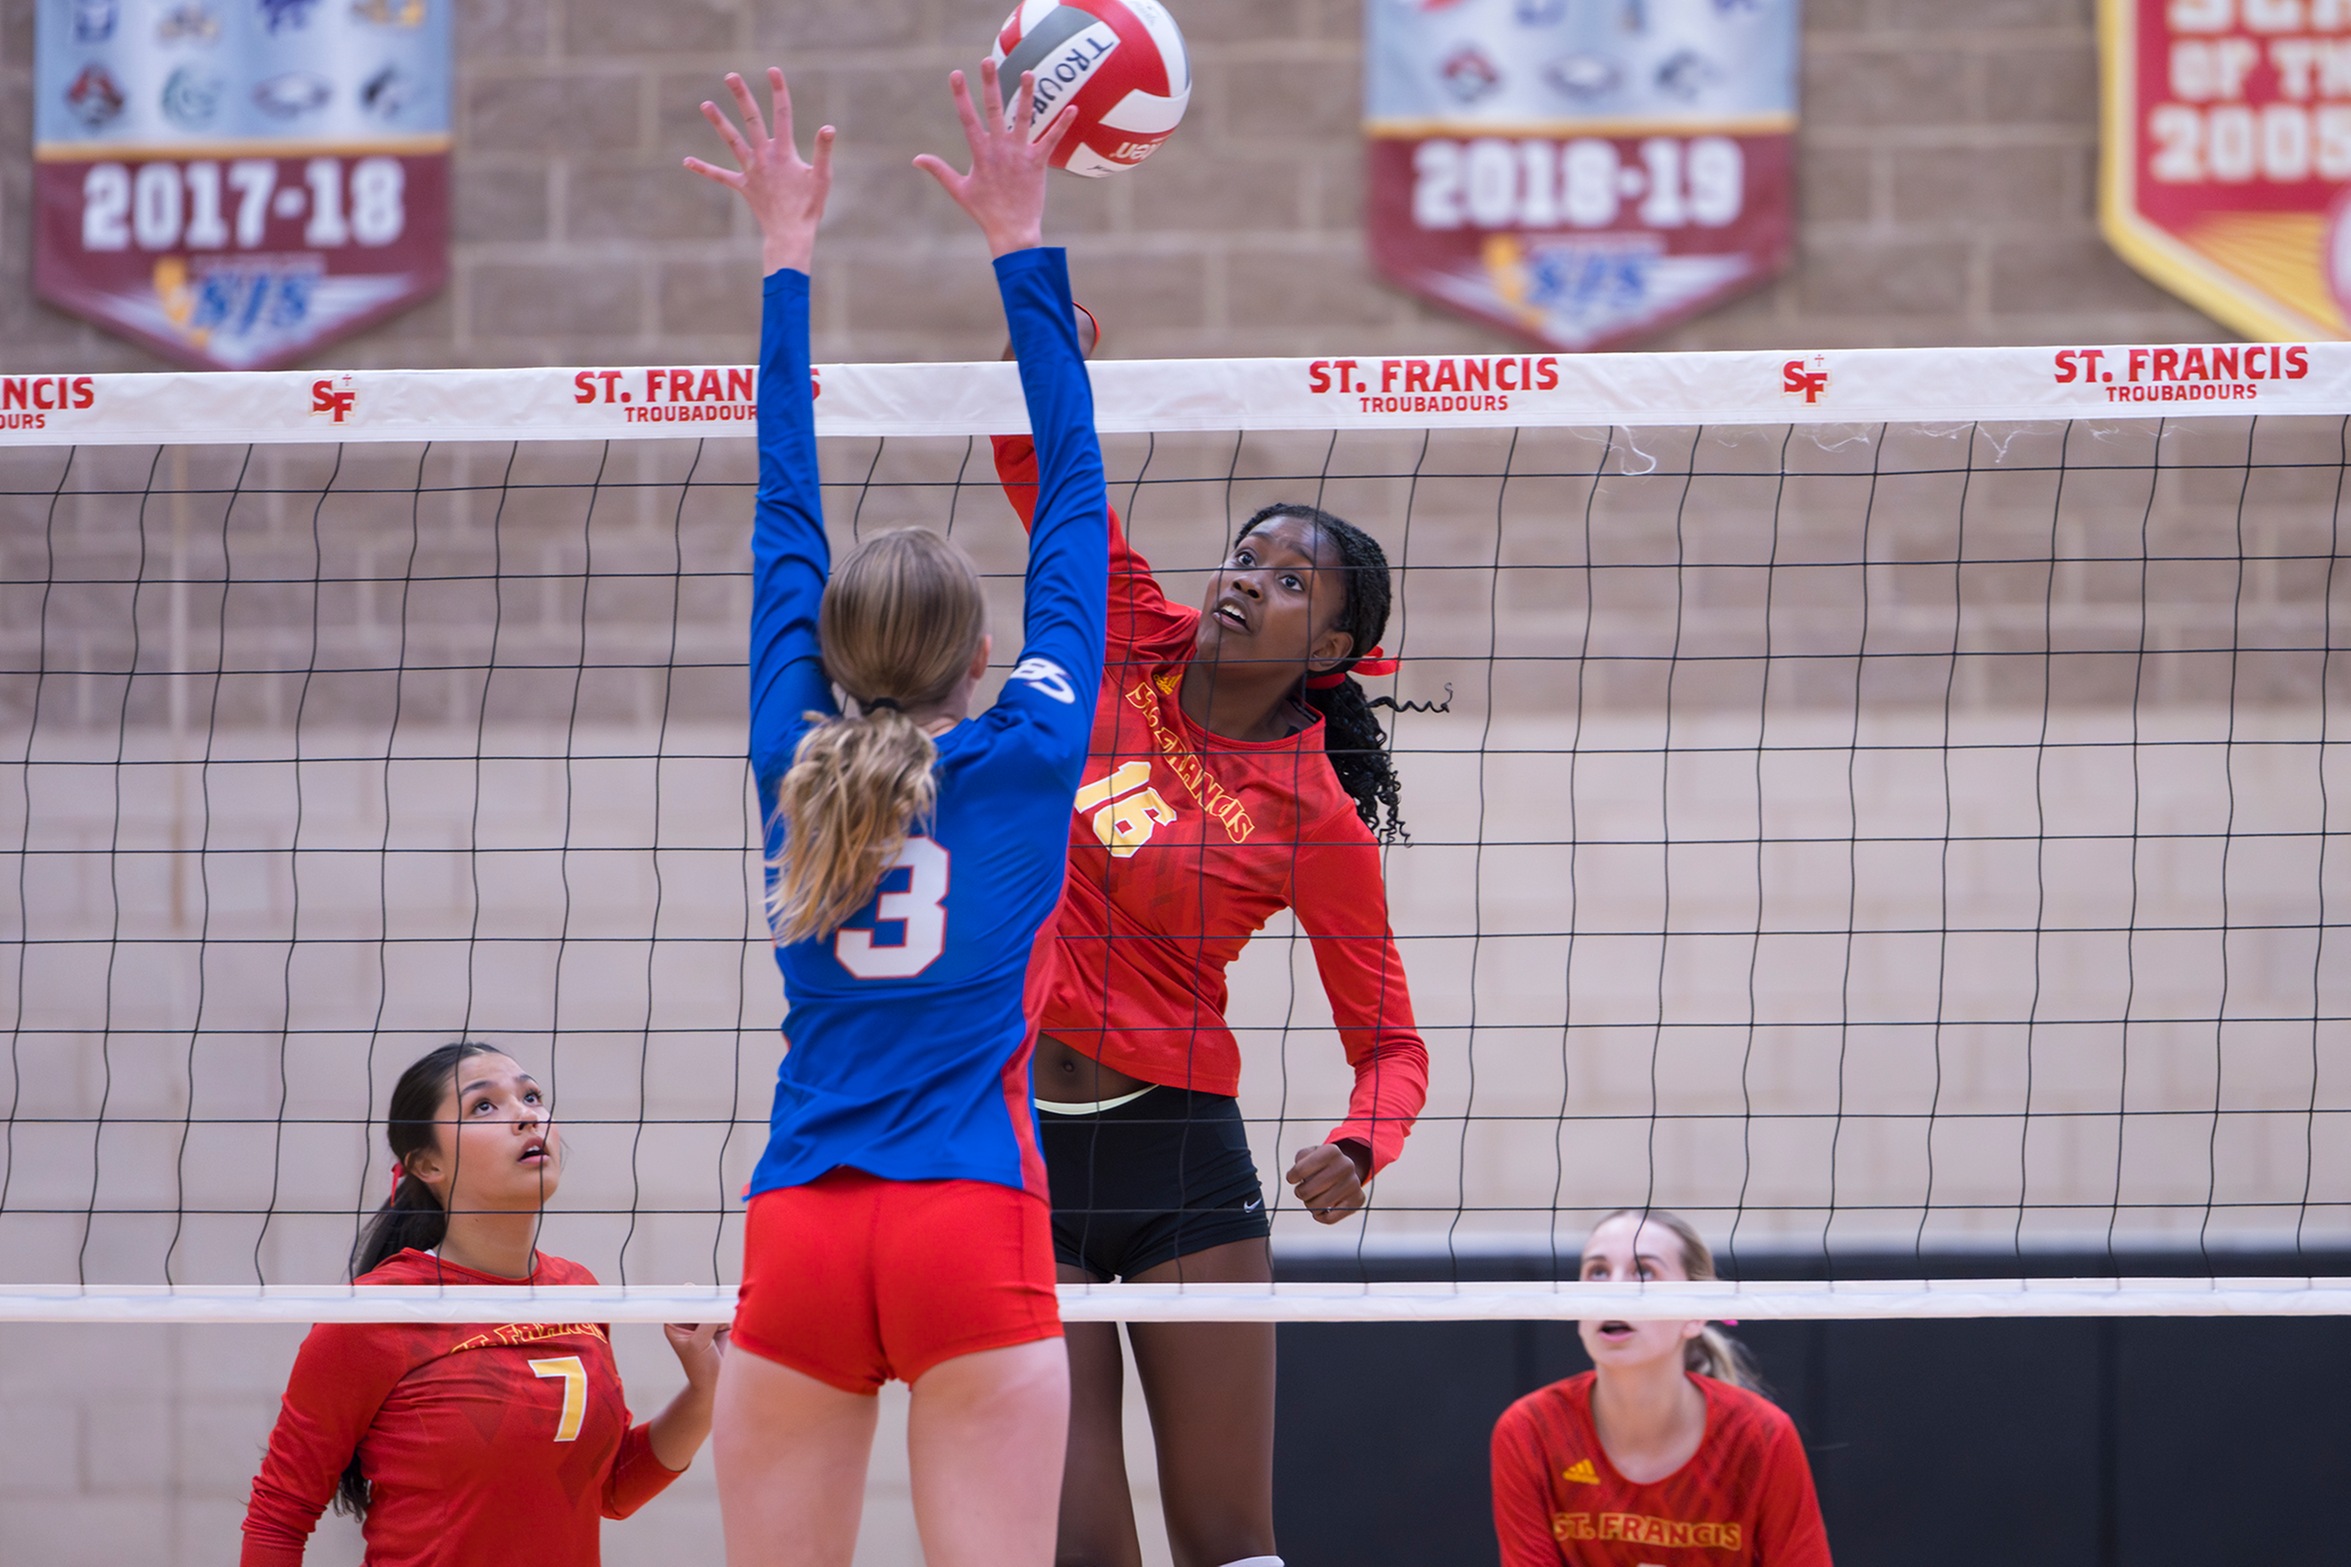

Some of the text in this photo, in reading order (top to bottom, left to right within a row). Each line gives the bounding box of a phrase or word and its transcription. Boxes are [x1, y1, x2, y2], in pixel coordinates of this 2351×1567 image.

[1411, 136, 1745, 230] 2018-19
[81, 157, 406, 252] 2017-18
[1309, 357, 1559, 394] ST. FRANCIS
[2054, 346, 2309, 384] ST. FRANCIS
[0, 377, 95, 410] NCIS
[574, 368, 821, 404] ST. FRAN
[1360, 395, 1508, 412] TROUBADOURS
[2106, 384, 2257, 402] TROUBADOURS
[624, 405, 758, 422] TROUBADOUR
[1153, 726, 1255, 844] FRANCIS
[1073, 761, 1178, 858] 16
[833, 834, 951, 980] 3
[527, 1355, 588, 1442] 7
[1599, 1511, 1742, 1551] FRANCIS
